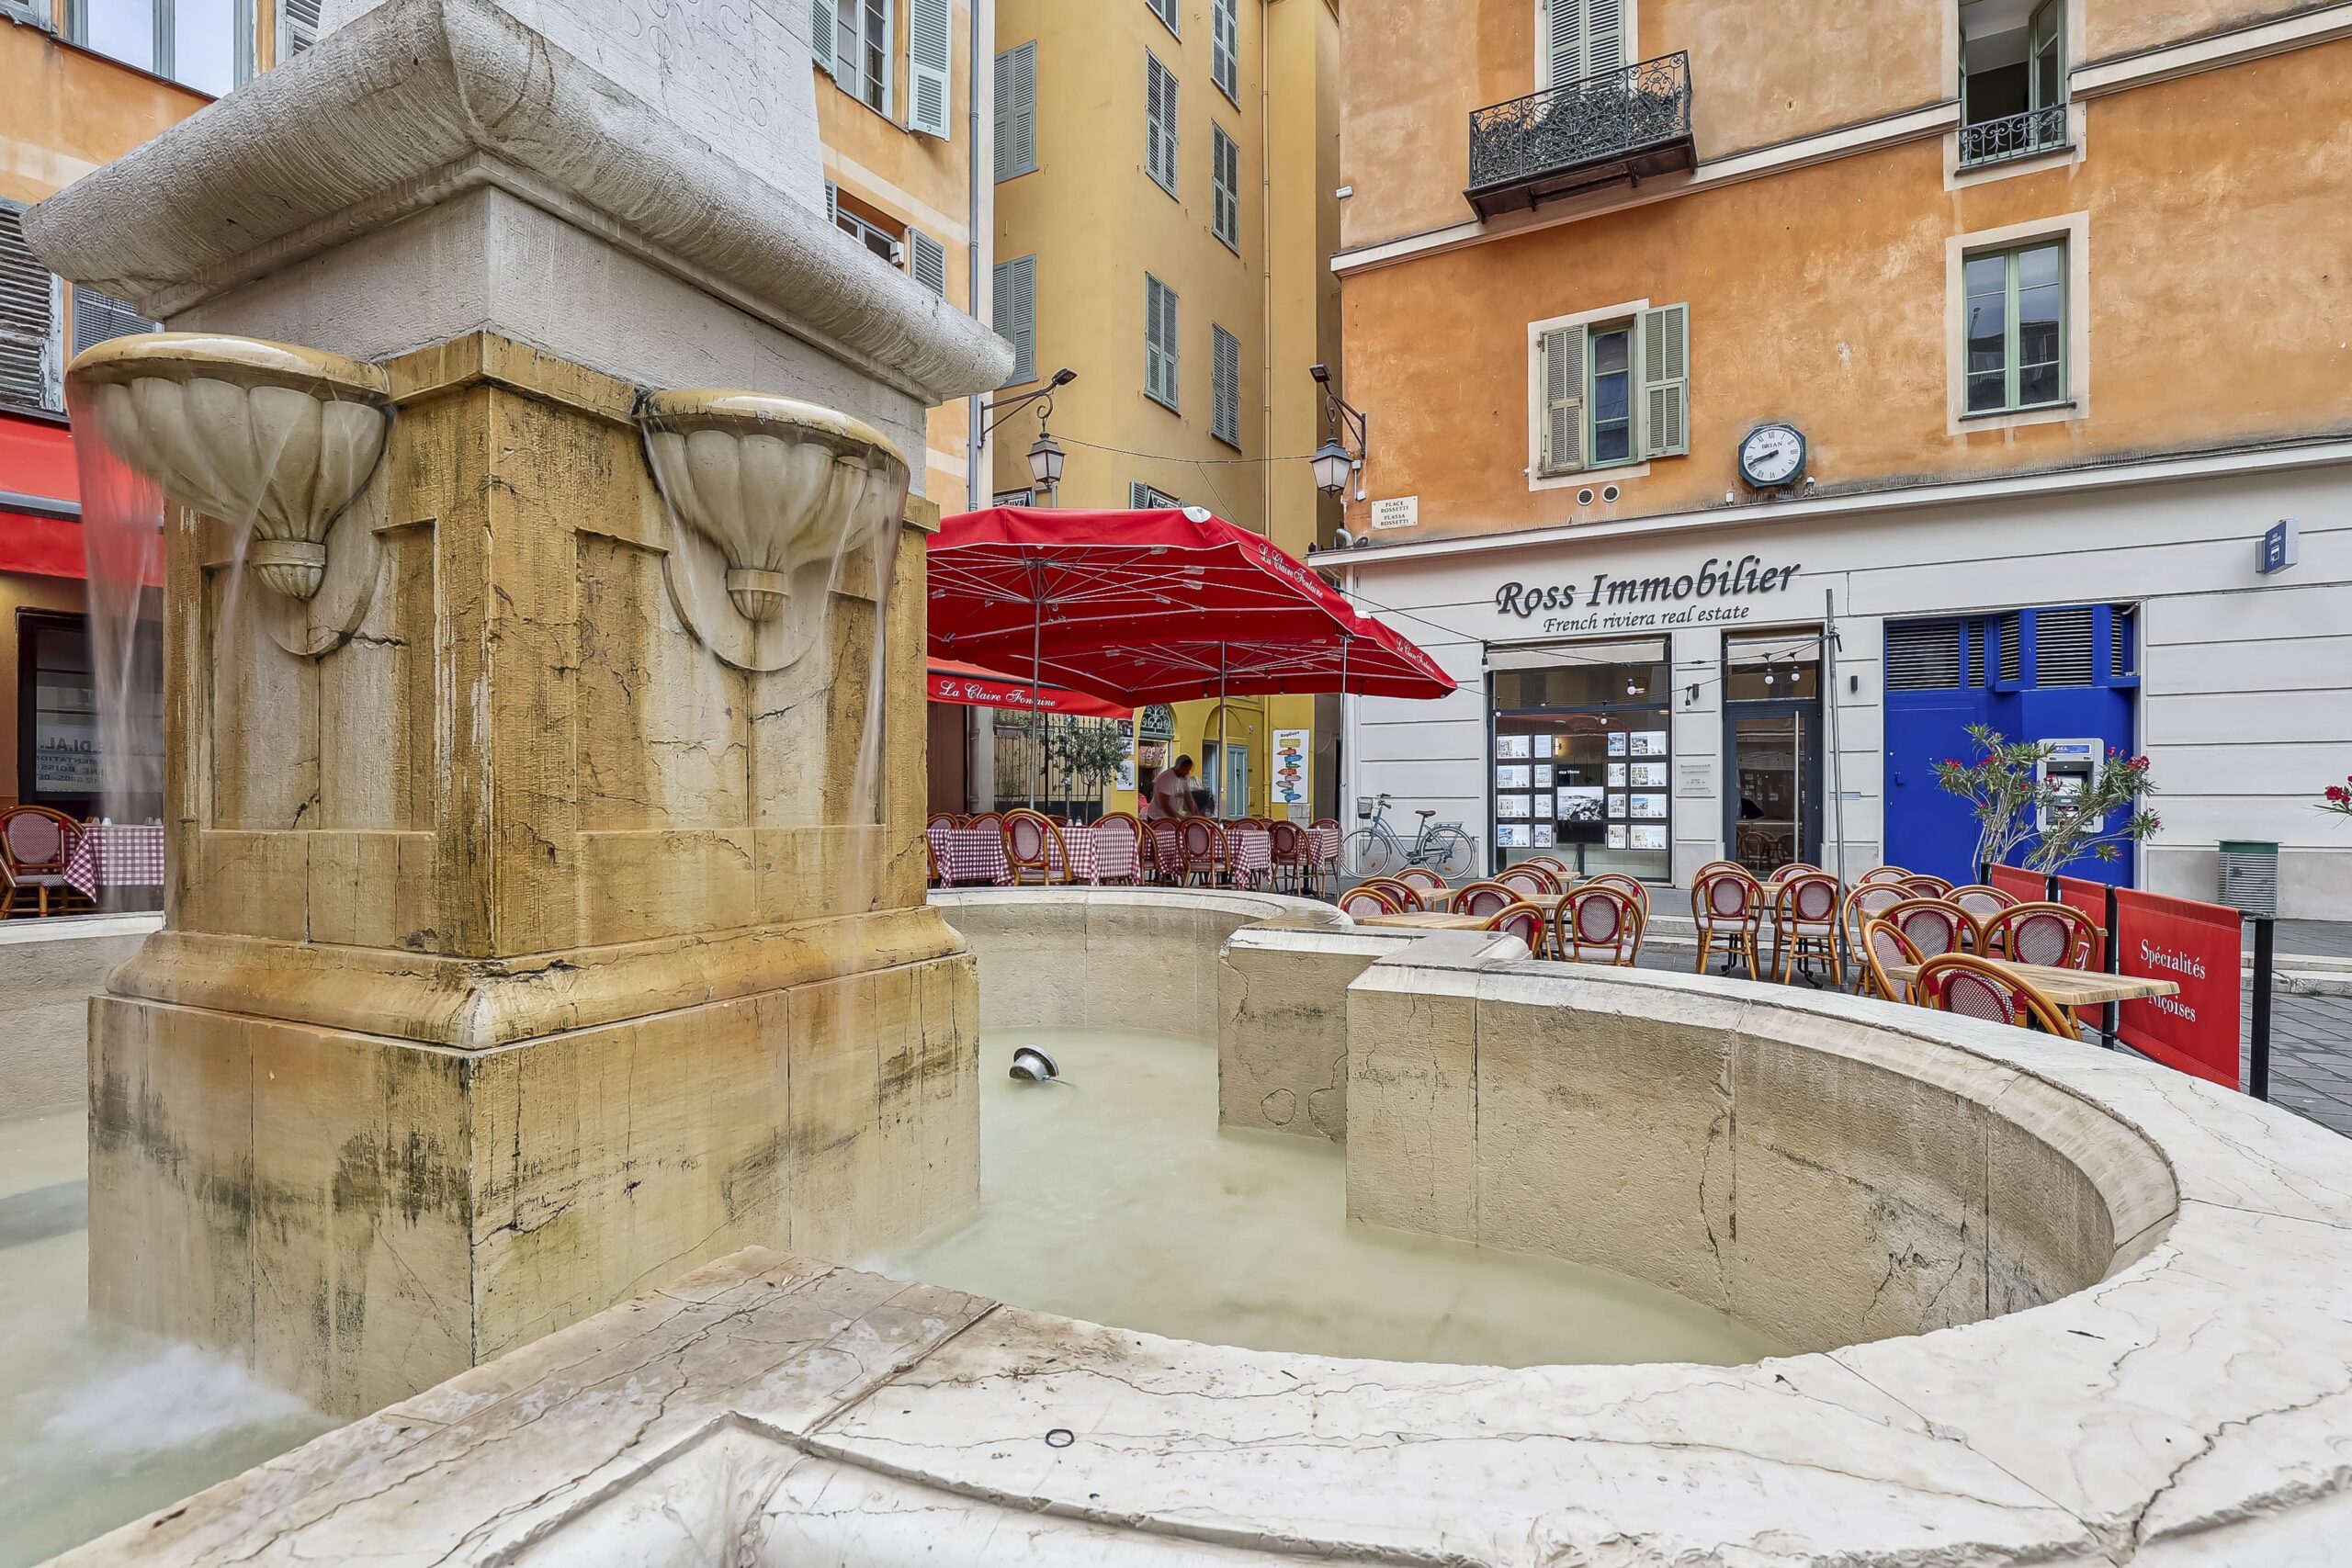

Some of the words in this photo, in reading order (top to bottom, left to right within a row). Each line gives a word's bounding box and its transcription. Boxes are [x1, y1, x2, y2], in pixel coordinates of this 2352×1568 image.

[1258, 543, 1272, 566] La
[1272, 549, 1294, 579] Claire
[1294, 568, 1323, 599] Fontaine
[1495, 581, 1576, 617] Ross
[1586, 554, 1802, 607] Immobilier
[1544, 613, 1598, 634] French
[1602, 613, 1656, 629] riviera
[1661, 605, 1693, 624] real
[1698, 605, 1750, 622] estate
[939, 681, 960, 697] La
[964, 682, 1001, 702] Claire
[1005, 689, 1056, 707] Fonaine
[2140, 938, 2206, 980] Spécialités
